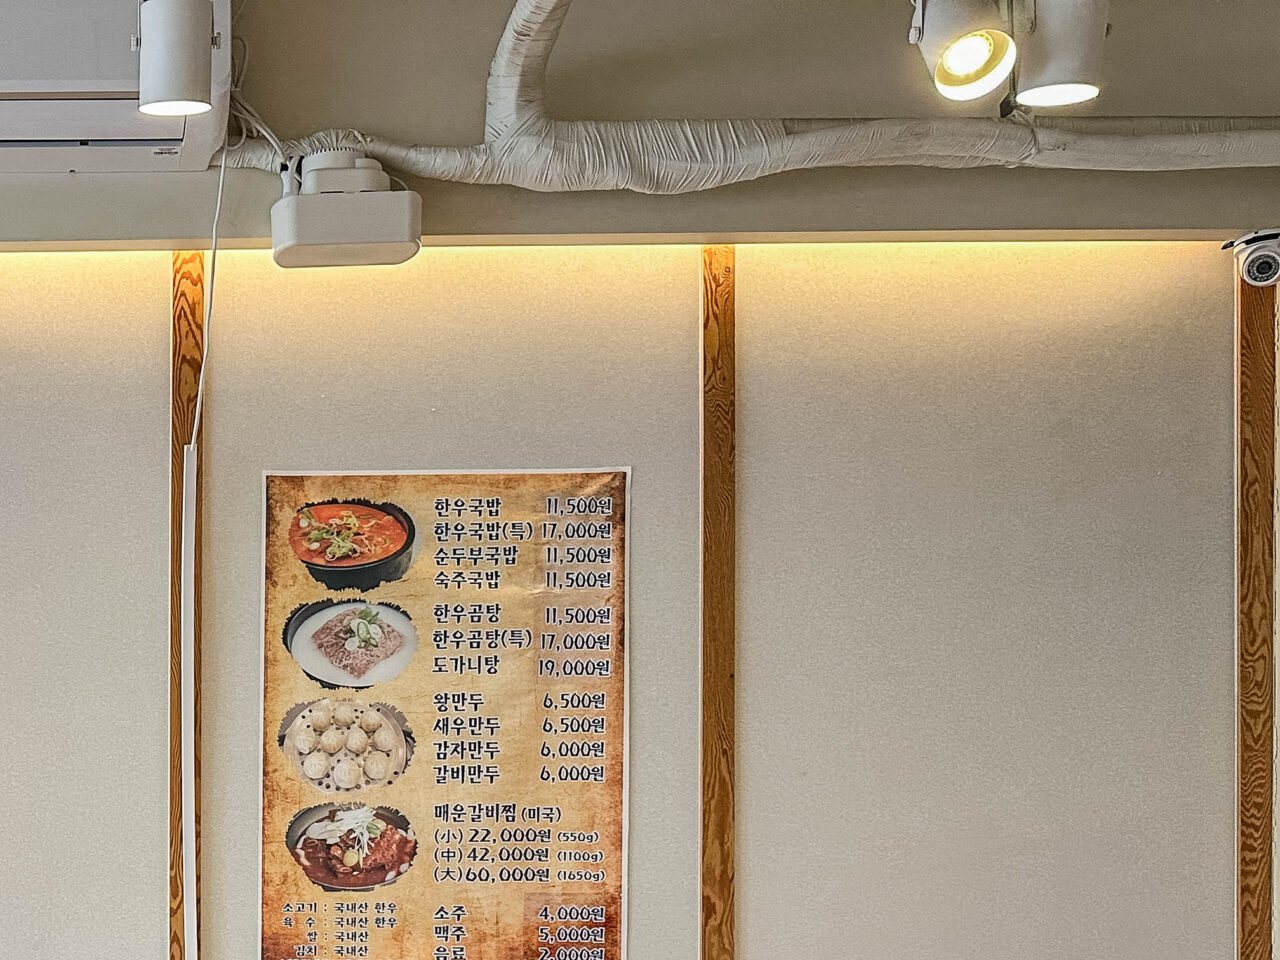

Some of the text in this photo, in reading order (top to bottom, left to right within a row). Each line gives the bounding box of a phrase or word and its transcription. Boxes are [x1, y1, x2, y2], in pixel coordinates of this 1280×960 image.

[434, 498, 611, 517] 한우국밥 11,500원
[434, 521, 611, 542] 한우국밥(특) 17,000원
[434, 545, 611, 566] 순두부국밥 11,500원
[434, 570, 611, 590] 숙주국밥 11,500원
[433, 603, 611, 625] 한우곰탕 11,500원
[433, 629, 610, 651] 한우곰탕(특) 17,000원
[432, 655, 610, 677] 도가니탕 19,000원
[433, 692, 605, 712] 왕만두 6,500원
[433, 717, 605, 736] 새우만두 6,500원
[433, 741, 605, 760] 감자만두 6,000원
[433, 765, 605, 784] 갈비만두 6,000원
[434, 803, 561, 823] 매운갈비찜 (미국)
[434, 828, 599, 844] (小) 22,000원 (550g)
[434, 847, 604, 863] (中) 42,000원 (1100g)
[557, 870, 606, 882] (1650g)
[282, 903, 317, 913] 소고기
[334, 902, 369, 914] 국내산
[374, 902, 398, 914] 한우
[433, 906, 605, 922] 소주 4,000원
[334, 917, 369, 928] 국내산
[374, 917, 398, 928] 한우
[307, 931, 318, 943] 쌀
[334, 931, 369, 943] 국내산
[434, 926, 605, 943] 맥주 5,000원
[295, 946, 317, 957] 김치
[334, 945, 369, 957] 국내산
